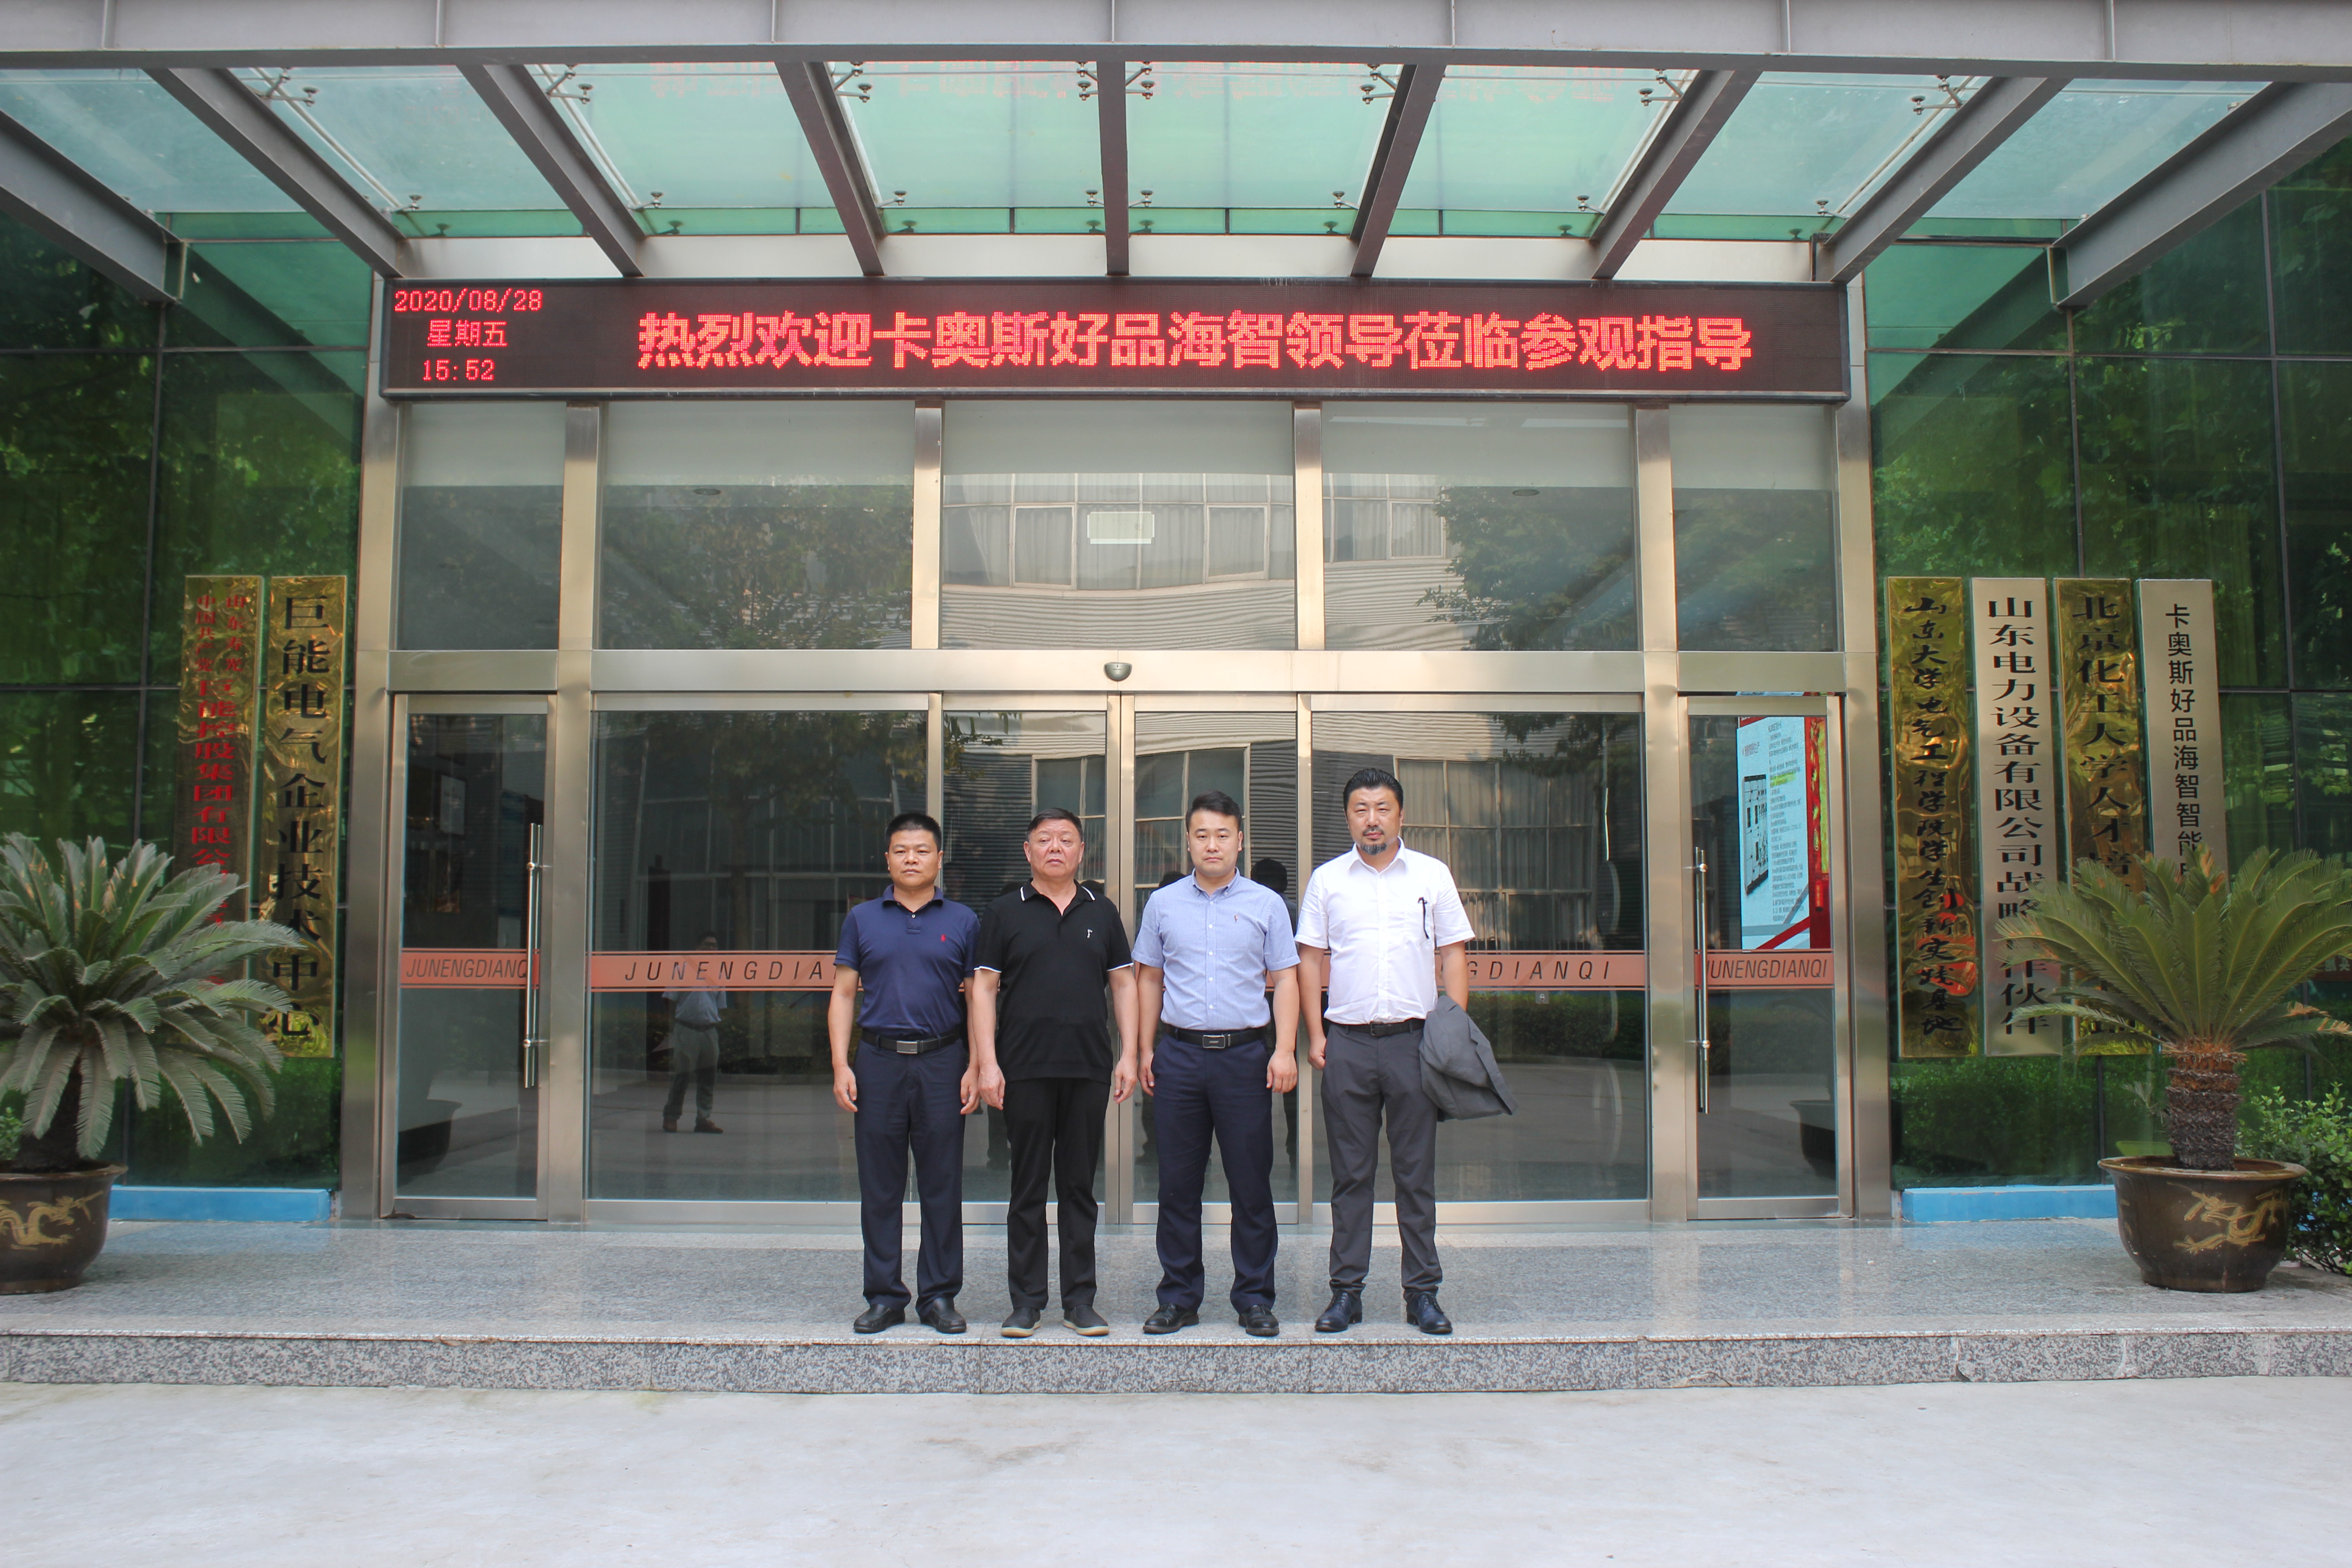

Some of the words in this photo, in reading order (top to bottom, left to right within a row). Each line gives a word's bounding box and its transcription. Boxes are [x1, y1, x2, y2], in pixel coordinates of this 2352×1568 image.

[393, 288, 543, 313] 2020/08/28
[426, 318, 509, 348] 星期五
[637, 309, 1753, 373] 热烈欢迎卡奥斯好品海智领导莅临参观指导
[422, 358, 495, 382] 15:52
[196, 595, 216, 672] 中国共产党
[226, 595, 248, 672] 山东寿光
[2165, 604, 2202, 876] 卡奥斯好品海智智能
[1988, 597, 2050, 1035] 山东电力设备有限公司战略作伙伴
[625, 961, 838, 980] JUNENGDIA
[1440, 961, 1609, 980] GDIANQI
